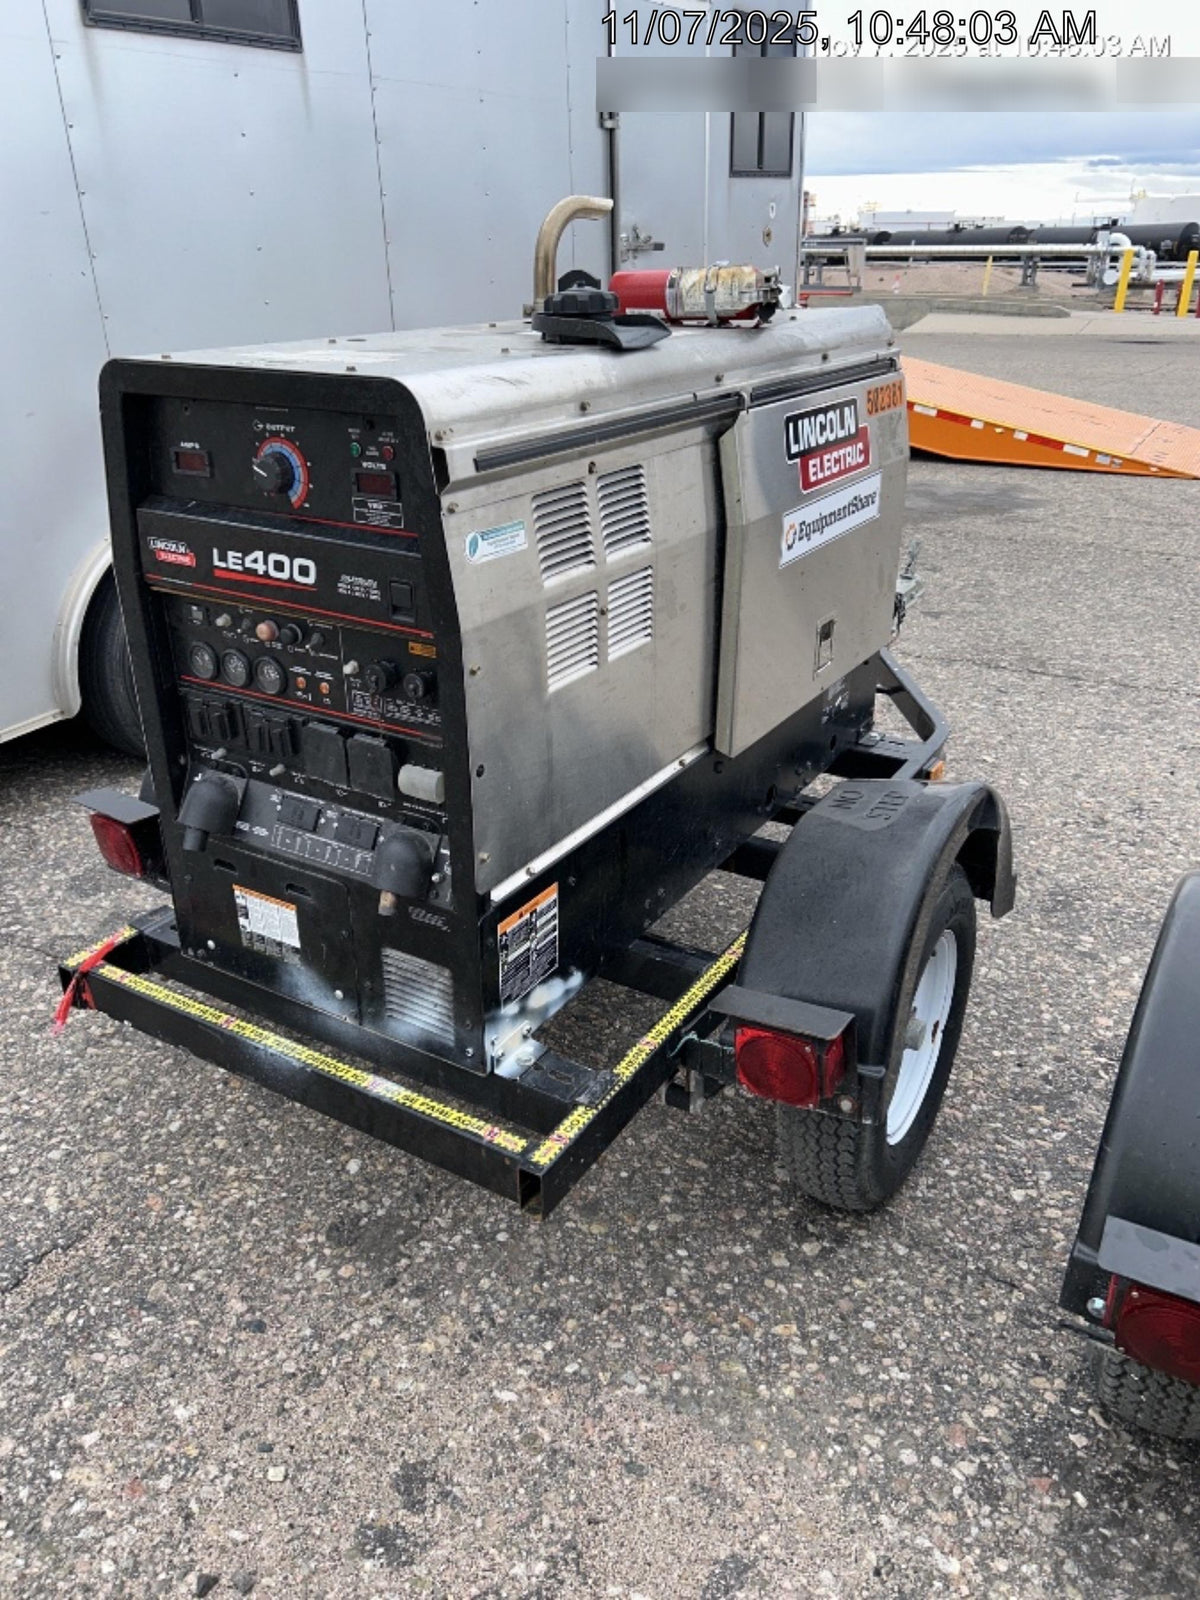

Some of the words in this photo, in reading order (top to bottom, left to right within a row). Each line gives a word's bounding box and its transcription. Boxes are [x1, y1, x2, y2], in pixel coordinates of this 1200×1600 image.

[788, 403, 857, 455] LINCOLN
[808, 441, 866, 484] ELECTRIC
[797, 489, 879, 542] EquipmentShare
[150, 537, 187, 554] LINCOLN
[212, 547, 317, 585] LE400
[828, 790, 865, 810] NO
